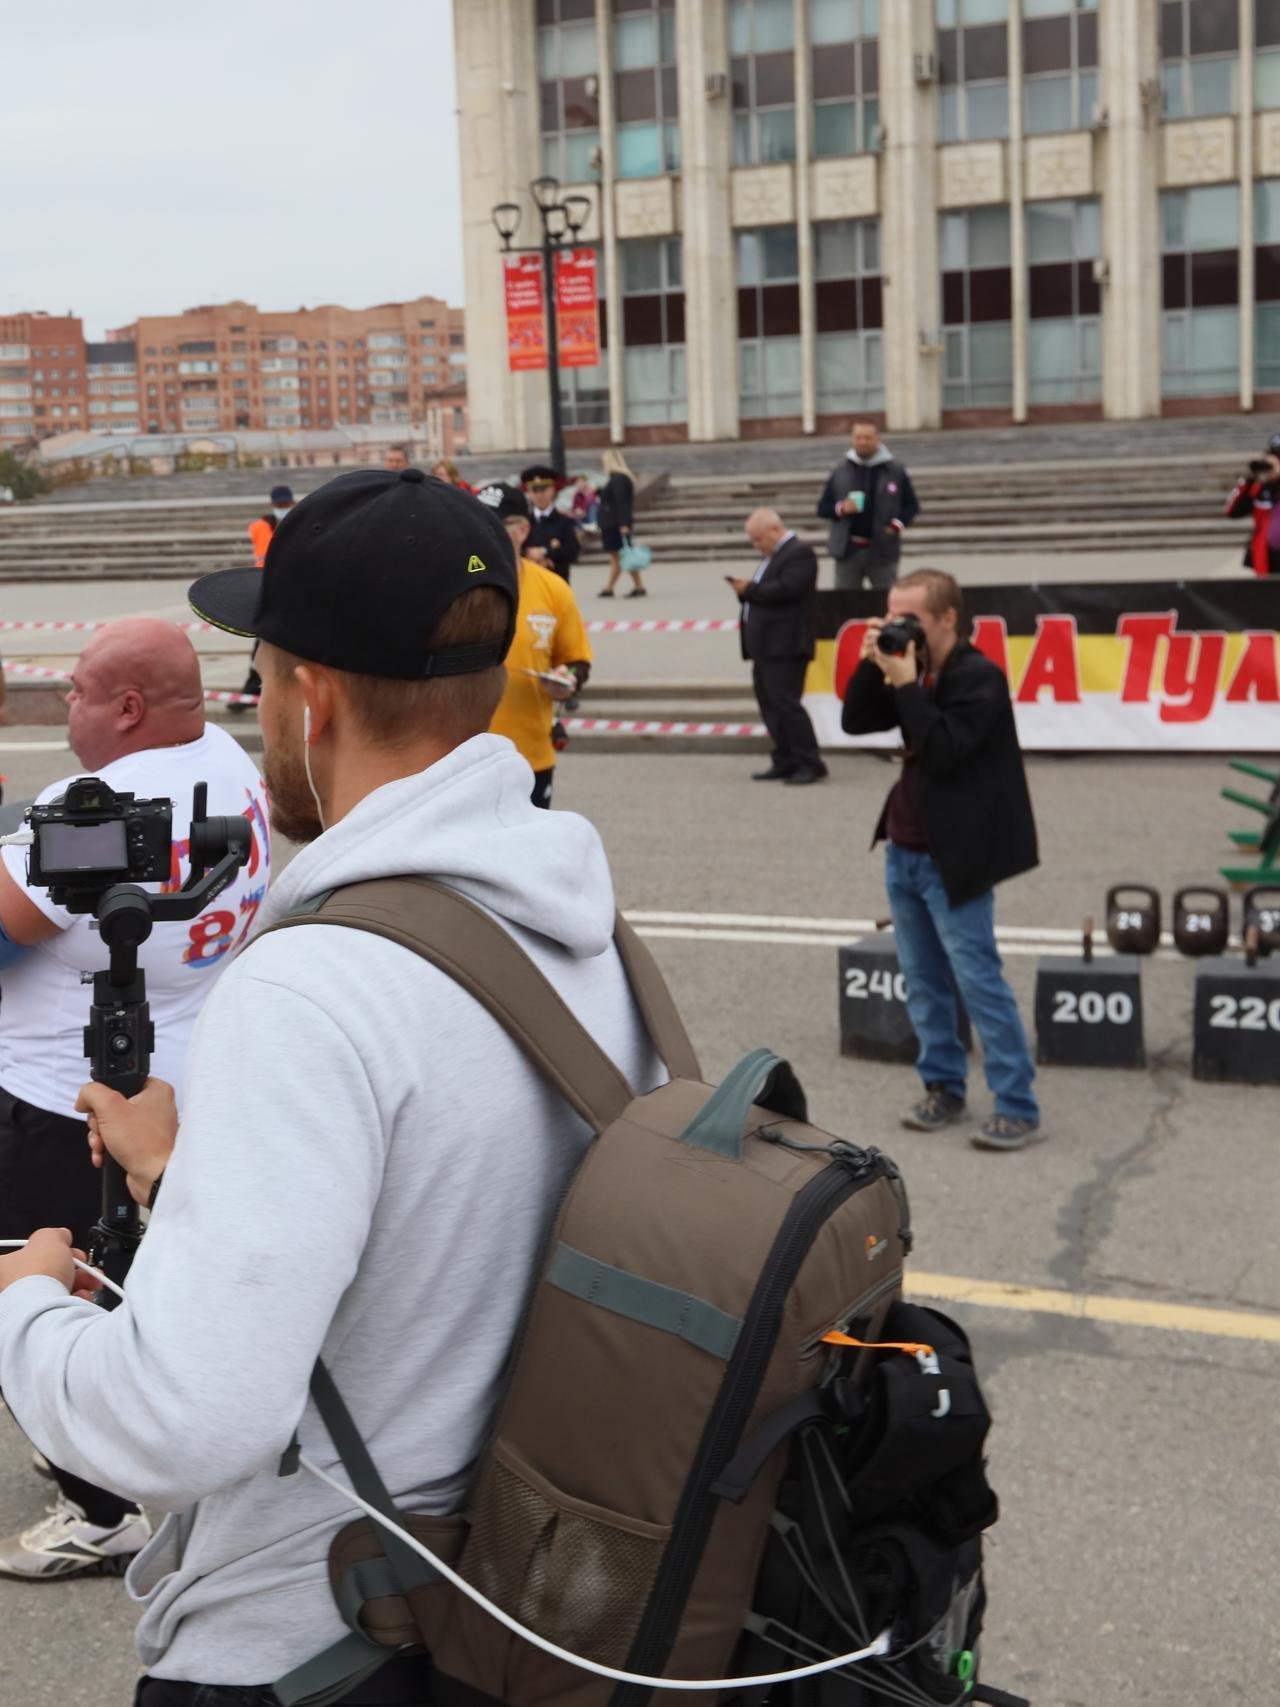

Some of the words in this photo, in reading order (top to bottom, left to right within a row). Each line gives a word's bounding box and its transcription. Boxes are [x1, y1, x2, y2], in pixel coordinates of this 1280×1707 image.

[182, 885, 264, 969] 87
[1117, 911, 1142, 930] 24
[1185, 914, 1211, 932] 24
[1051, 990, 1134, 1024] 200
